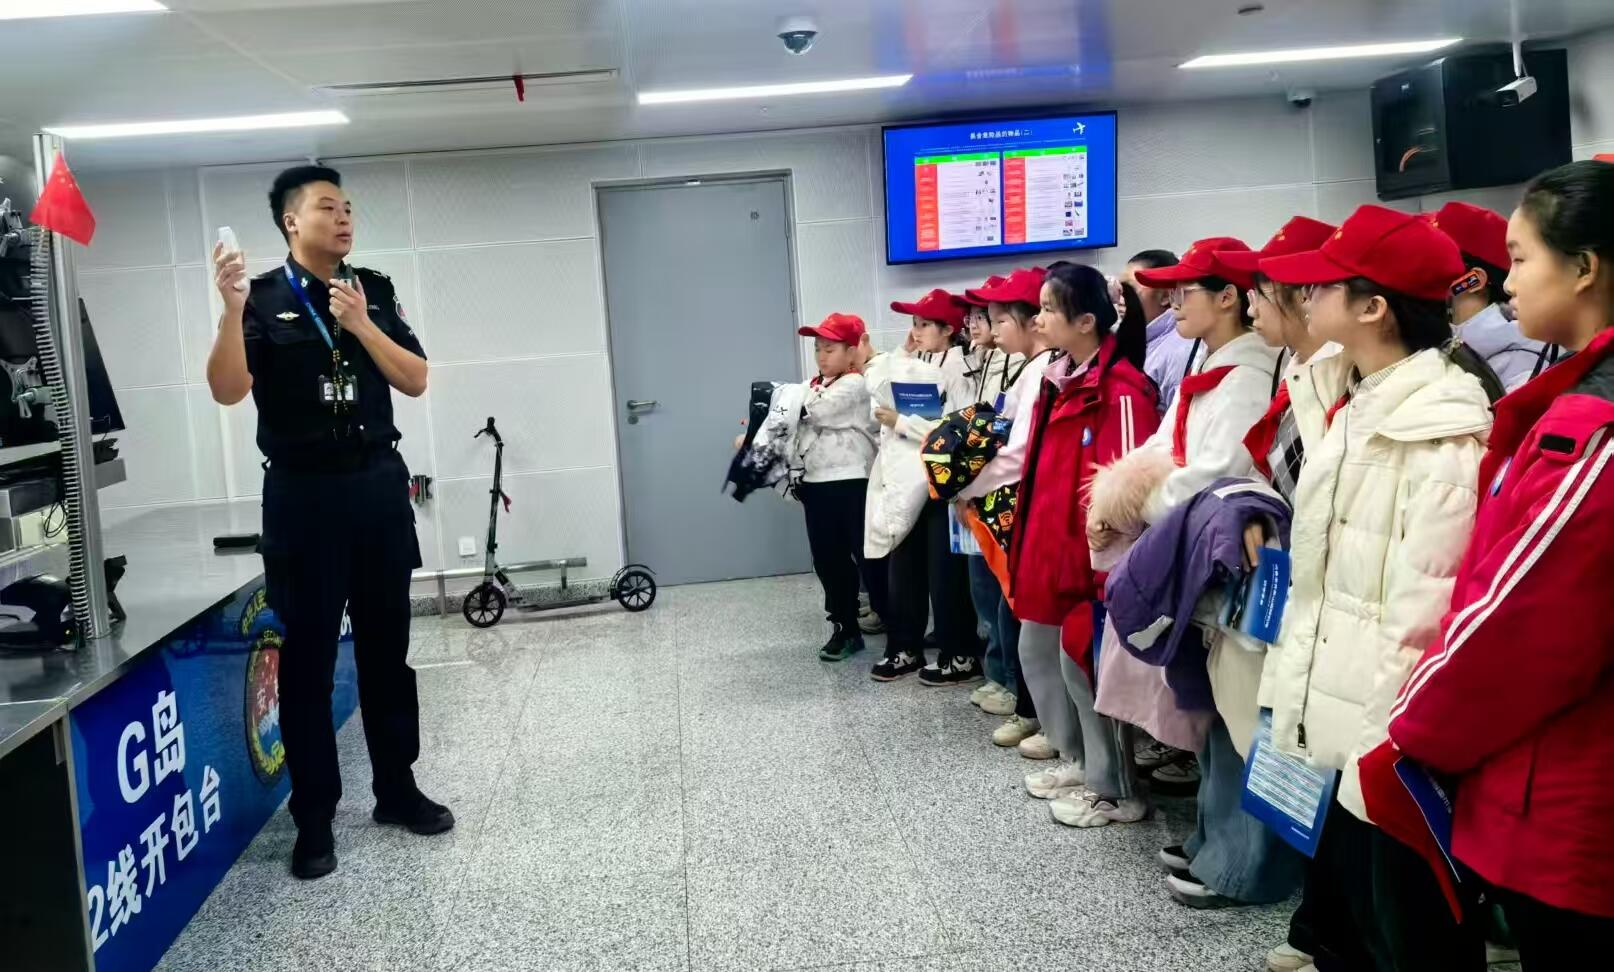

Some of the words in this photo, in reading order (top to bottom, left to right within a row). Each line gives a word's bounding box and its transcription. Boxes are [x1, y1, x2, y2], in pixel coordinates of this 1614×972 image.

[117, 690, 186, 803] G岛
[87, 765, 221, 953] 2线开包台
